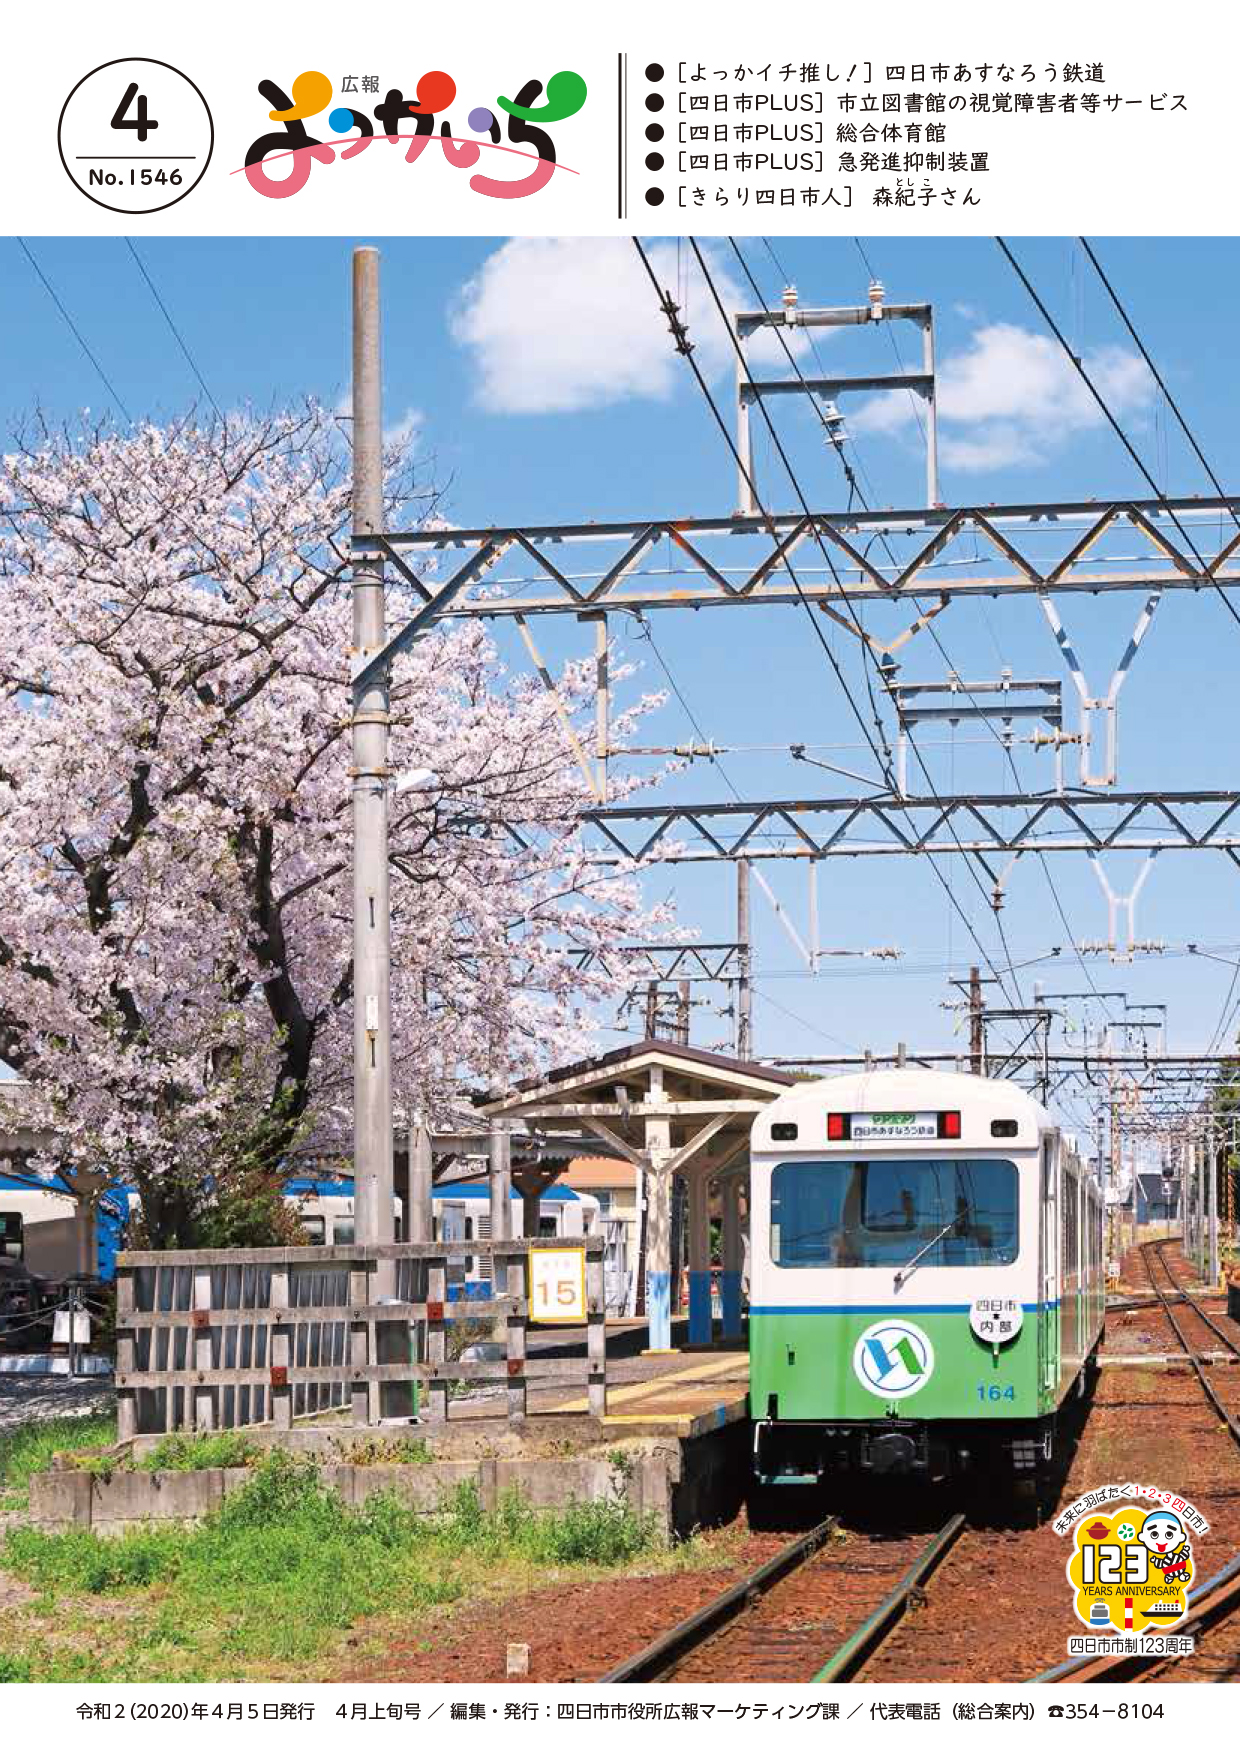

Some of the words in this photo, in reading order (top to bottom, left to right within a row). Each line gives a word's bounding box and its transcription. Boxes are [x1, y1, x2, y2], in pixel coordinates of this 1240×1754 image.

[536, 1280, 577, 1306] 15
[976, 1300, 1016, 1312] 四日市
[977, 1385, 1015, 1401] 164
